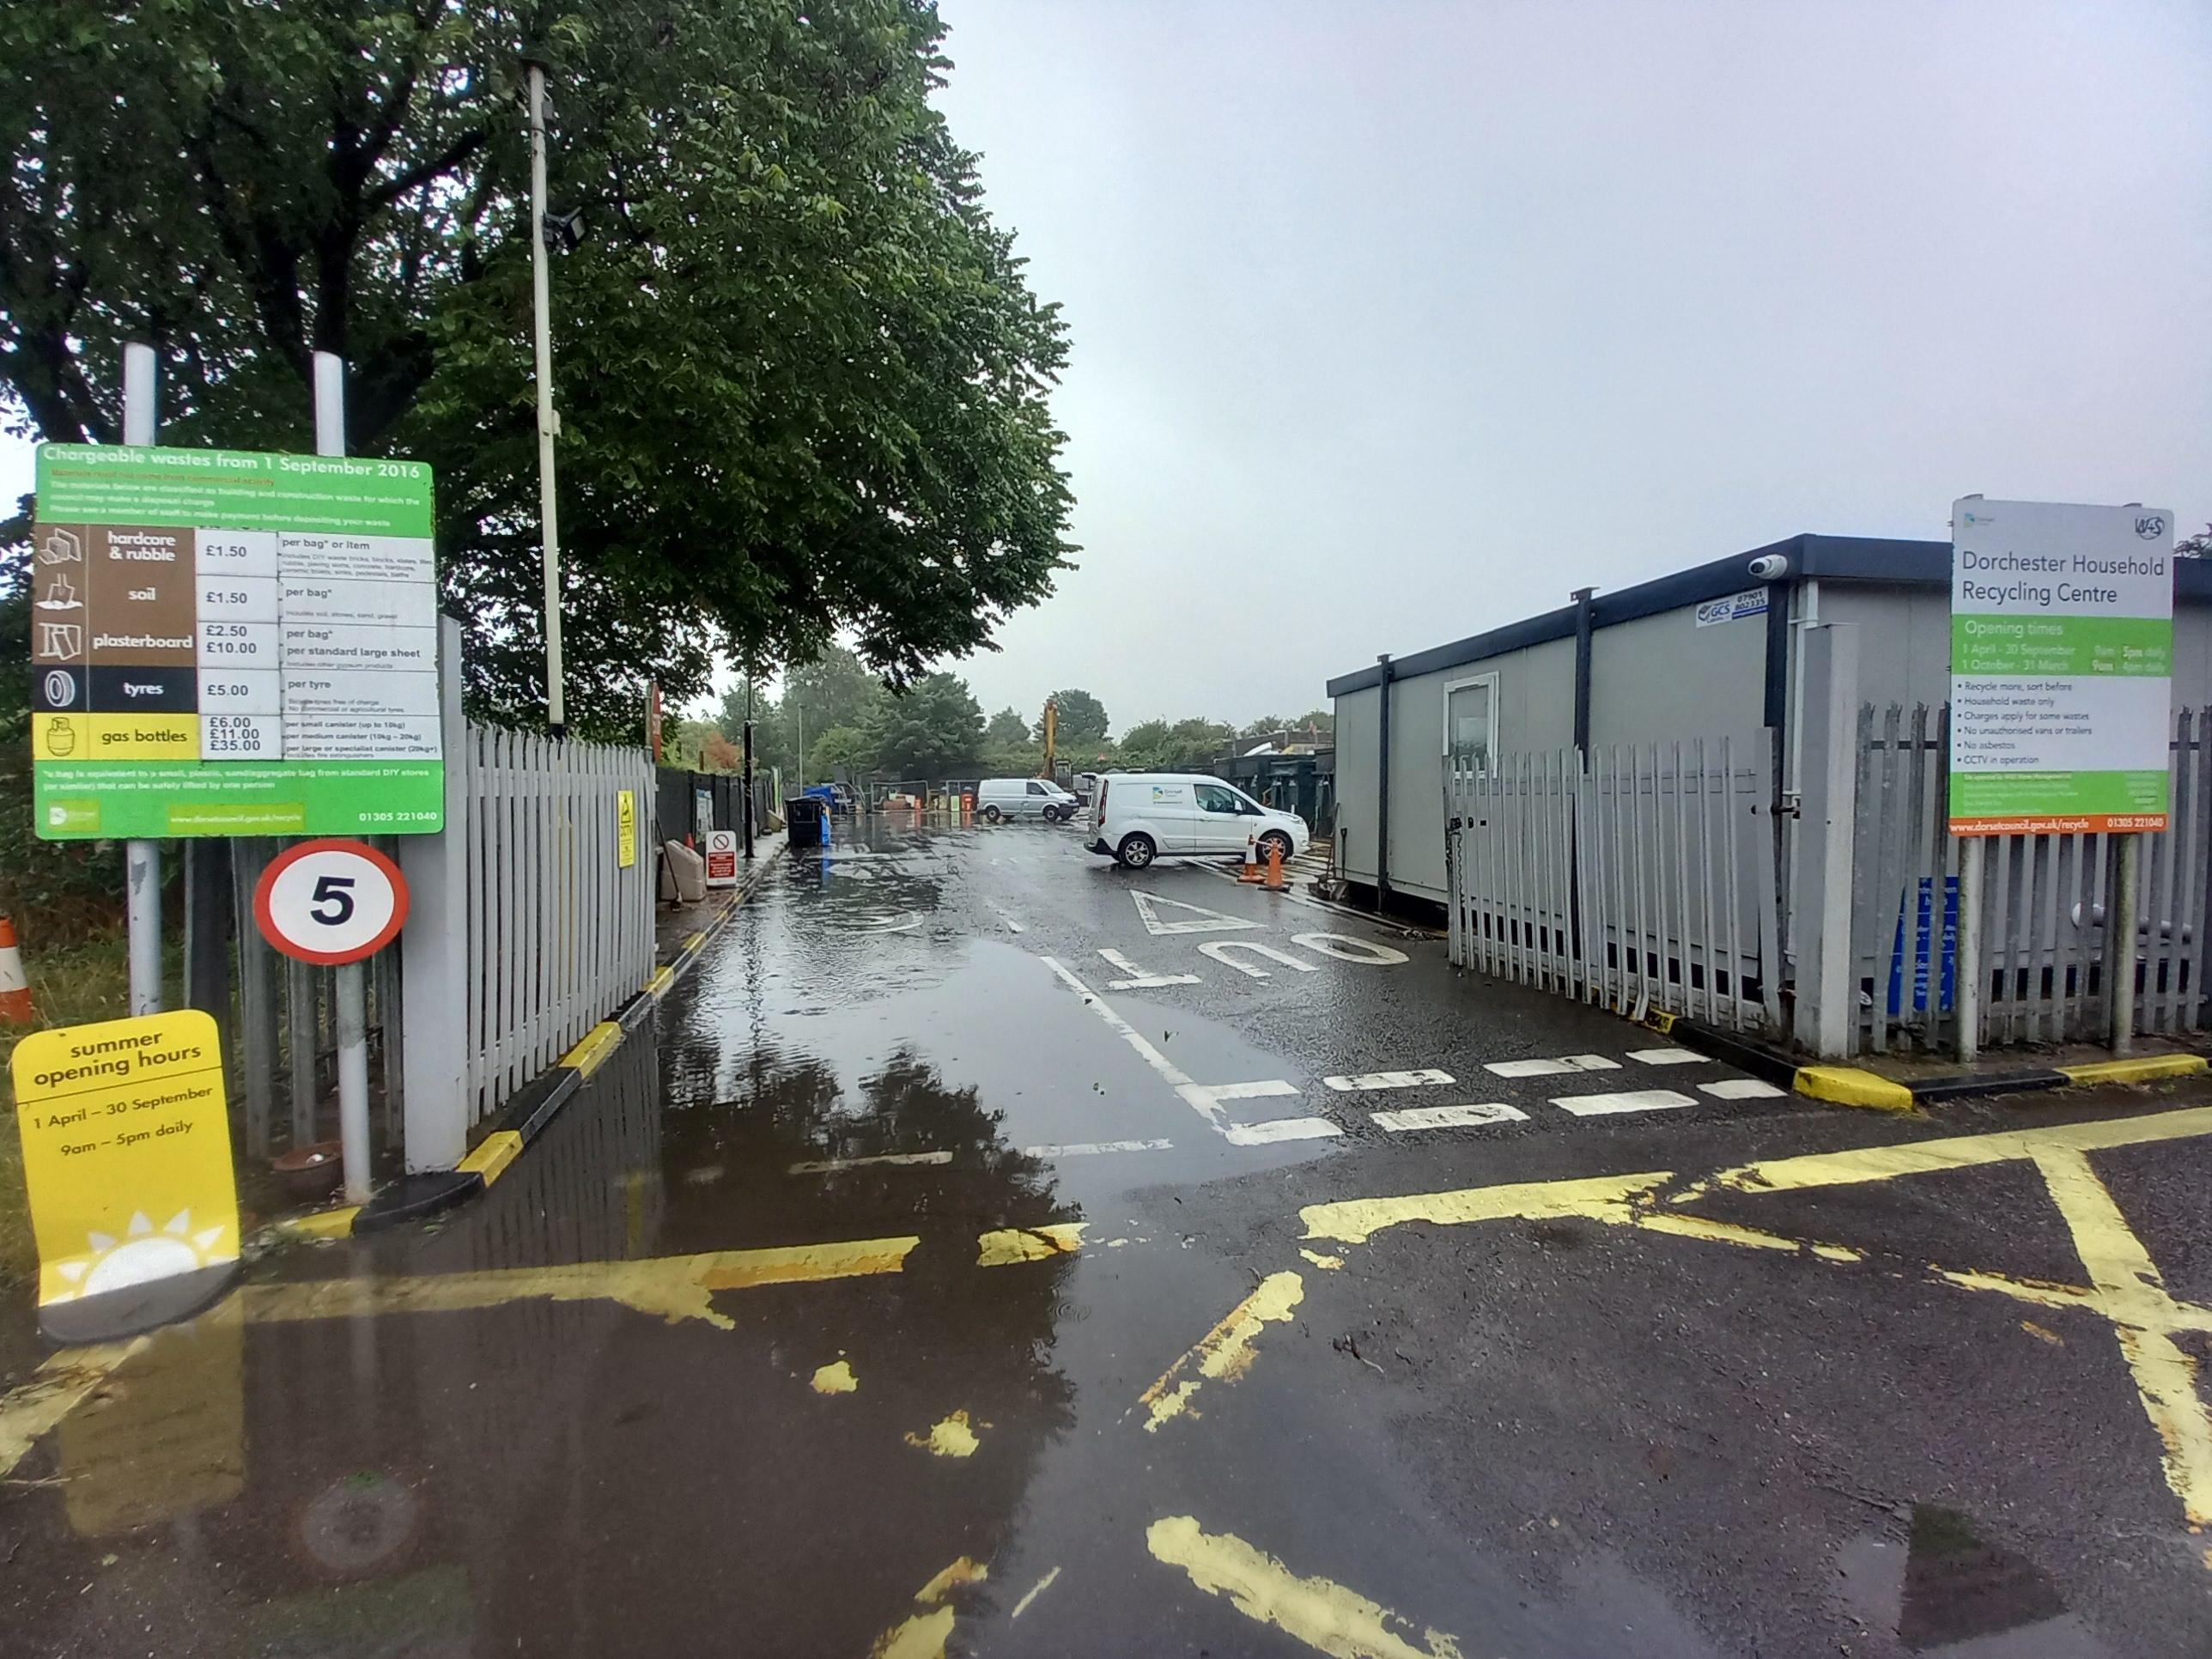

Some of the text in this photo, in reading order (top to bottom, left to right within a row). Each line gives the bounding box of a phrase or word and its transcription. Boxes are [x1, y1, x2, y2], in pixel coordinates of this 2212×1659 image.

[43, 447, 420, 478] Chargeable wastes from 1 September 2016
[218, 488, 257, 498] building
[277, 491, 334, 501] construction
[363, 495, 376, 504] for
[378, 496, 404, 506] which
[107, 531, 177, 547] hardcore
[282, 538, 301, 549] per
[346, 540, 371, 550] item
[109, 546, 176, 562] & rubble
[206, 544, 247, 558] £1.50
[1962, 550, 2165, 576] Dorchester Household
[128, 587, 156, 601] soil
[206, 592, 247, 604] £1.50
[286, 588, 304, 597] per
[1962, 580, 2118, 606] Recycling Centre
[1711, 604, 1731, 617] GCS
[206, 625, 247, 637] £2.50
[287, 630, 305, 640] per
[1965, 620, 2063, 639] Opening times
[93, 634, 193, 649] plasterboard
[206, 642, 257, 653] £10.00
[287, 647, 421, 659] per standard large sheet
[1962, 644, 2076, 659] 1 April 30 September
[1962, 659, 2069, 671] 1 October 31 March
[123, 683, 164, 697] tyres
[207, 684, 249, 696] £5.00
[288, 680, 331, 690] per tyre
[1965, 681, 1997, 693] Recycle
[2027, 682, 2045, 691] sort
[2045, 681, 2073, 691] before
[1964, 696, 2010, 706] Household
[2038, 696, 2055, 708] only
[210, 717, 251, 729] £6.00
[1964, 711, 1999, 722] Charges
[2001, 712, 2024, 723] apply
[2025, 711, 2038, 720] for
[2063, 712, 2089, 721] wastes
[101, 728, 187, 745] gas bottles
[210, 728, 260, 740] £11.00
[1964, 726, 1977, 735] No
[1978, 726, 2033, 736] unauthorised
[2064, 726, 2093, 736] trailers
[210, 740, 261, 751] £35.00
[301, 744, 324, 754] large
[334, 744, 373, 754] specialist
[1964, 741, 2016, 750] No asbestos
[1963, 755, 2039, 767] CCTV in operation
[359, 811, 437, 822] 01305 221040
[310, 875, 356, 927] 5
[70, 1032, 163, 1058] summer
[34, 1047, 202, 1088] opening hours
[34, 1118, 40, 1129] 1
[48, 1109, 87, 1128] April
[106, 1102, 127, 1115] 30
[132, 1087, 213, 1110] September
[61, 1143, 96, 1156] 9am
[117, 1131, 150, 1146] 5pm
[155, 1119, 193, 1137] daily
